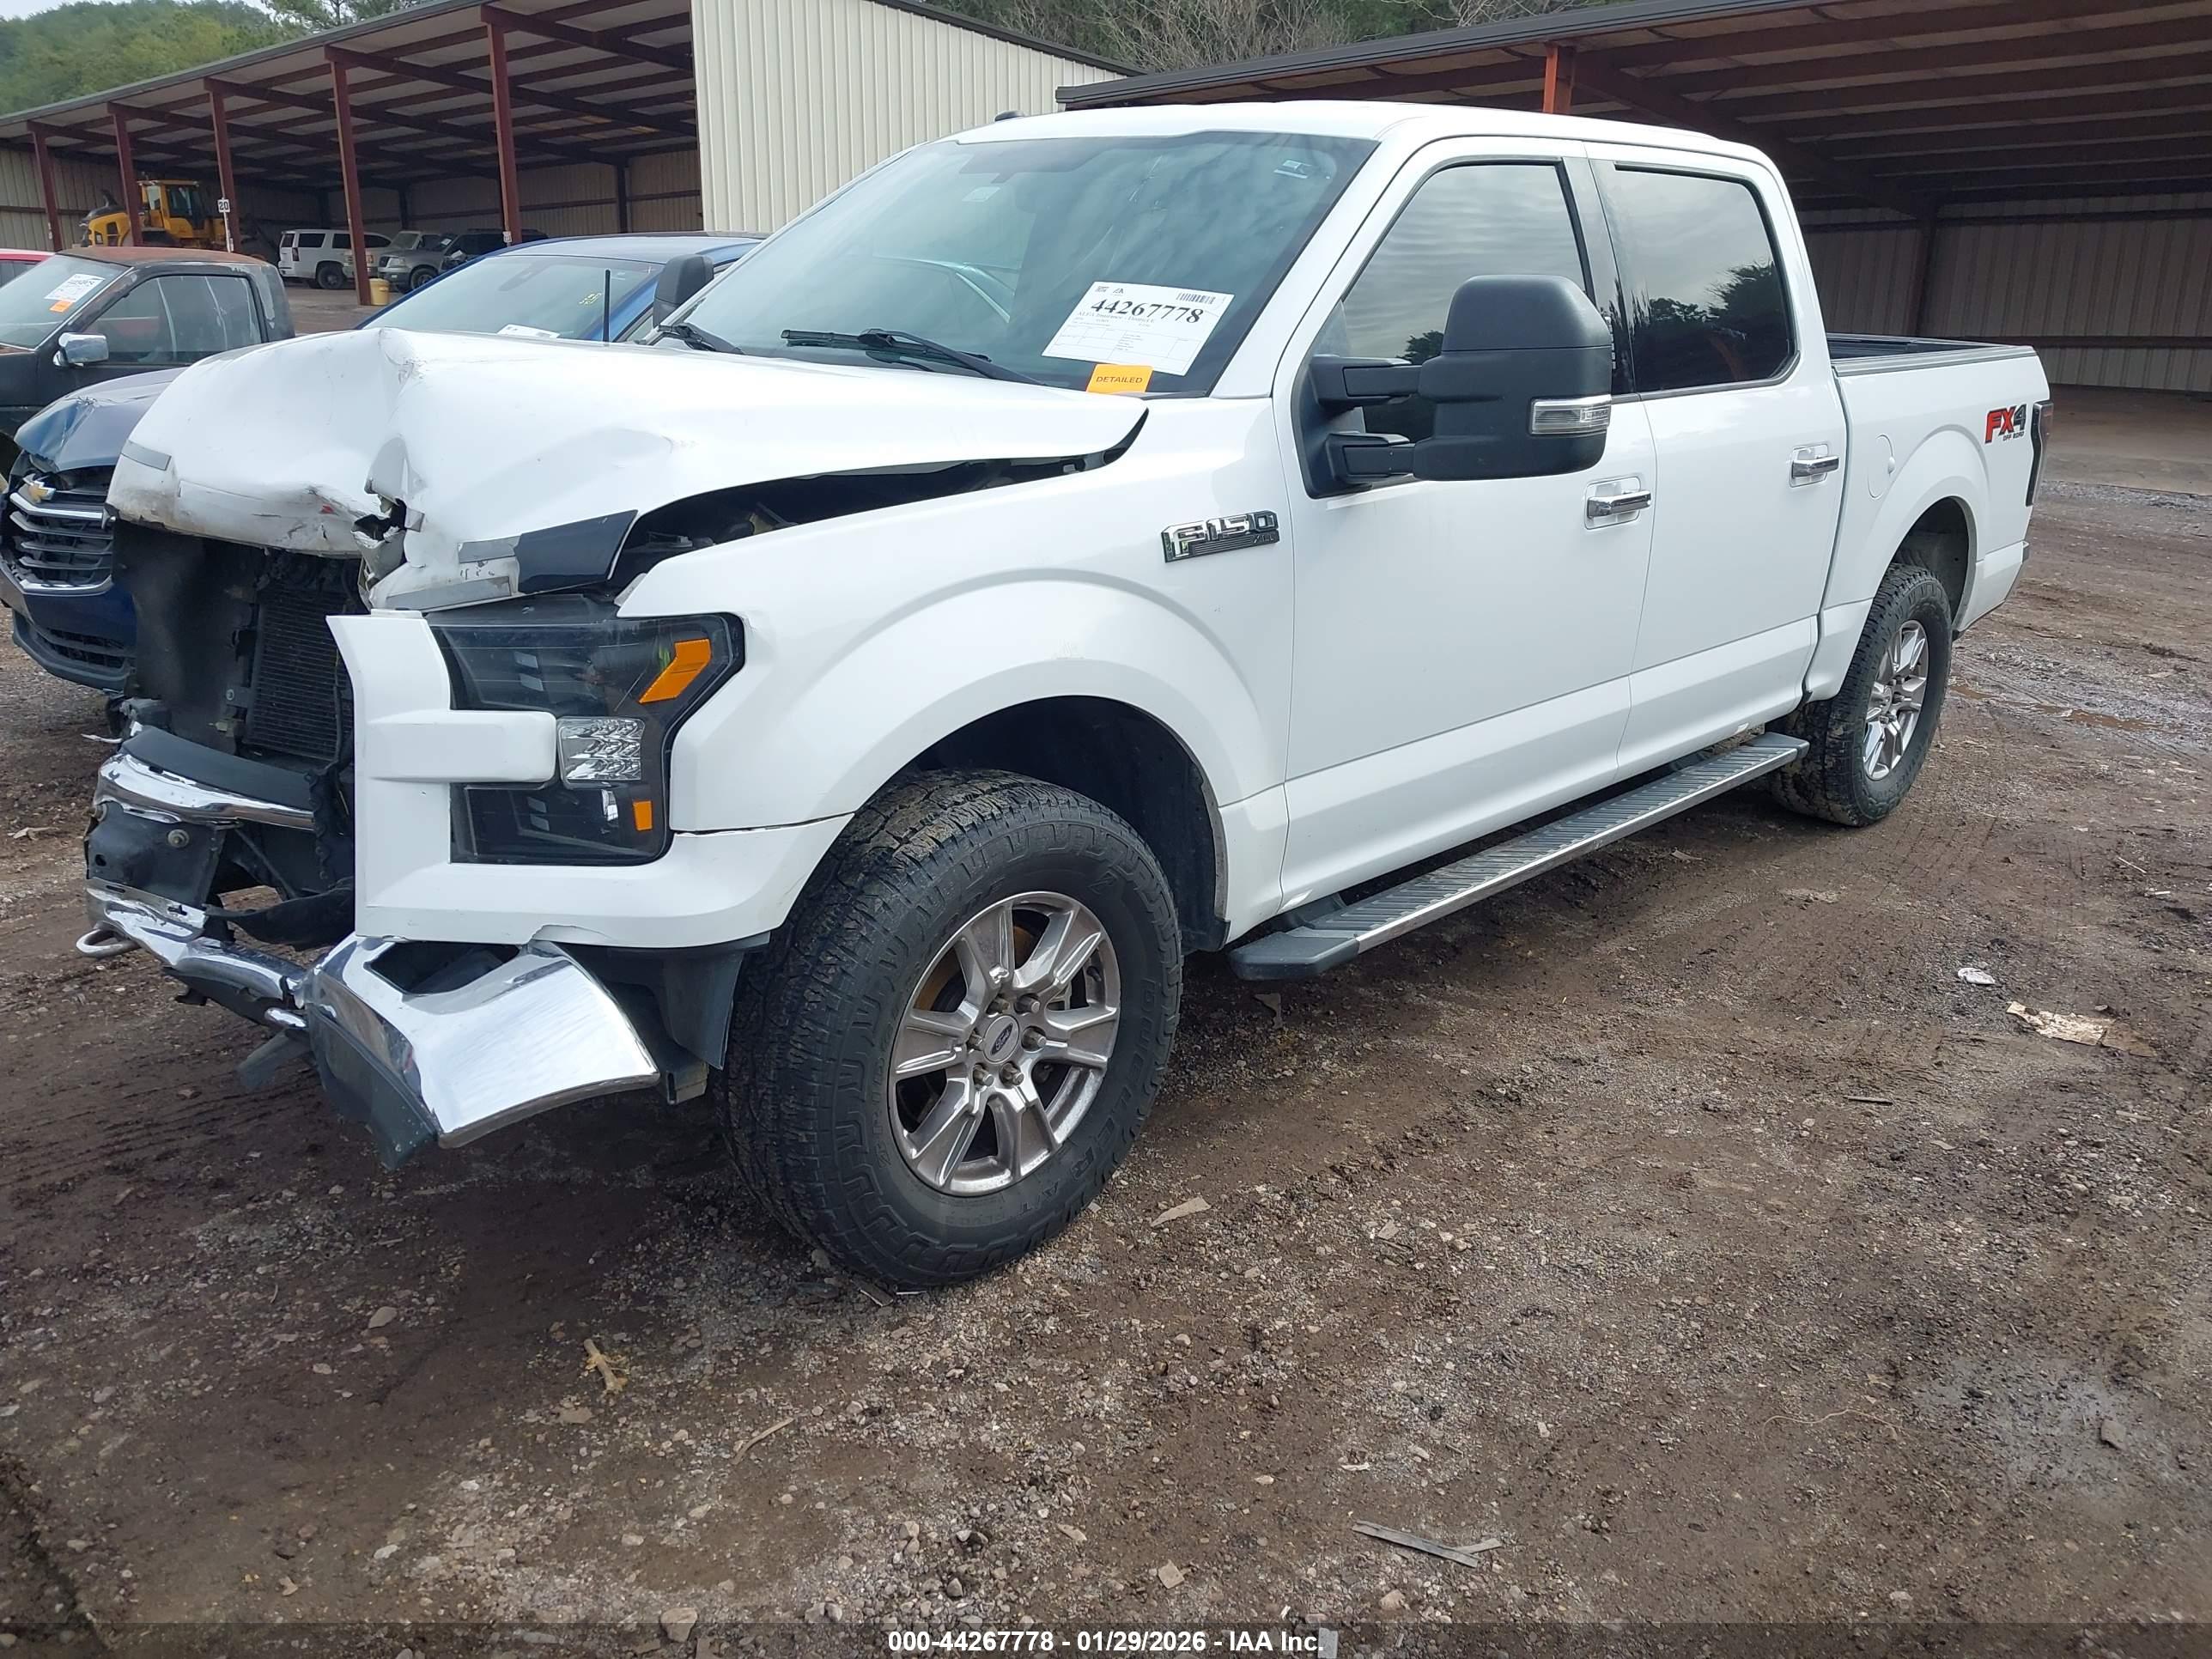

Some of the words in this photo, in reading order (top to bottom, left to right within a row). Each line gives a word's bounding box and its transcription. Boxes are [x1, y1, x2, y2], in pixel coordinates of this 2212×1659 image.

[219, 201, 229, 210] 20
[1091, 299, 1204, 323] 44267778
[1095, 375, 1144, 384] DETAILED
[1984, 404, 2027, 445] FX4
[994, 1028, 1012, 1052] Ford
